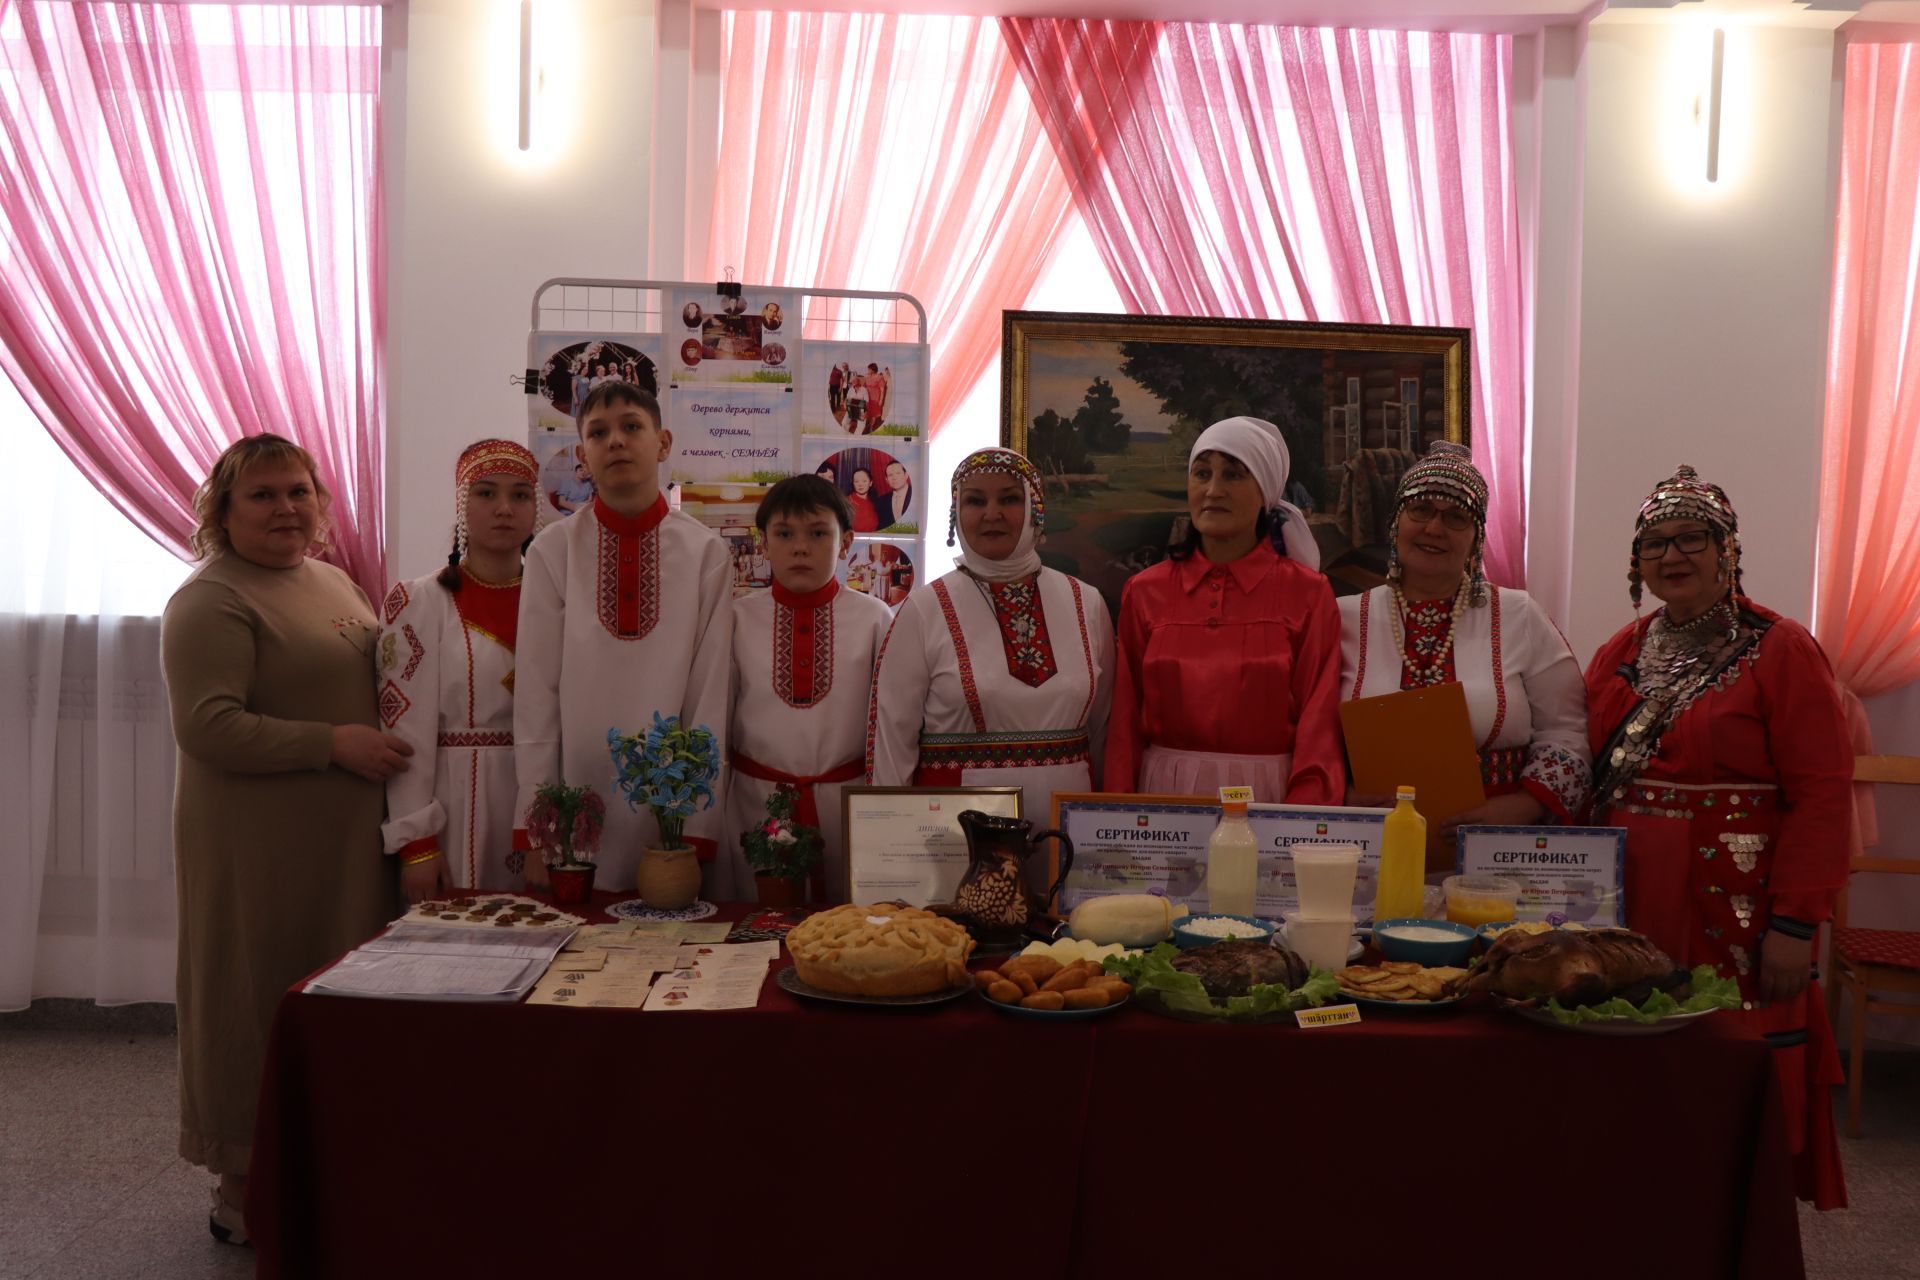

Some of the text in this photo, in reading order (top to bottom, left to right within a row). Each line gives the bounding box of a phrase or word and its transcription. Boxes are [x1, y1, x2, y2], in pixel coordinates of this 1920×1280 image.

[692, 404, 770, 416] Дерево держится
[709, 427, 751, 437] корнями,
[682, 449, 688, 457] а
[690, 449, 726, 459] человек
[731, 447, 779, 457] СЕМЬЁЙ
[1096, 828, 1190, 841] СЕРТИФИКАТ
[1493, 852, 1588, 864] СЕРТИФИКАТ
